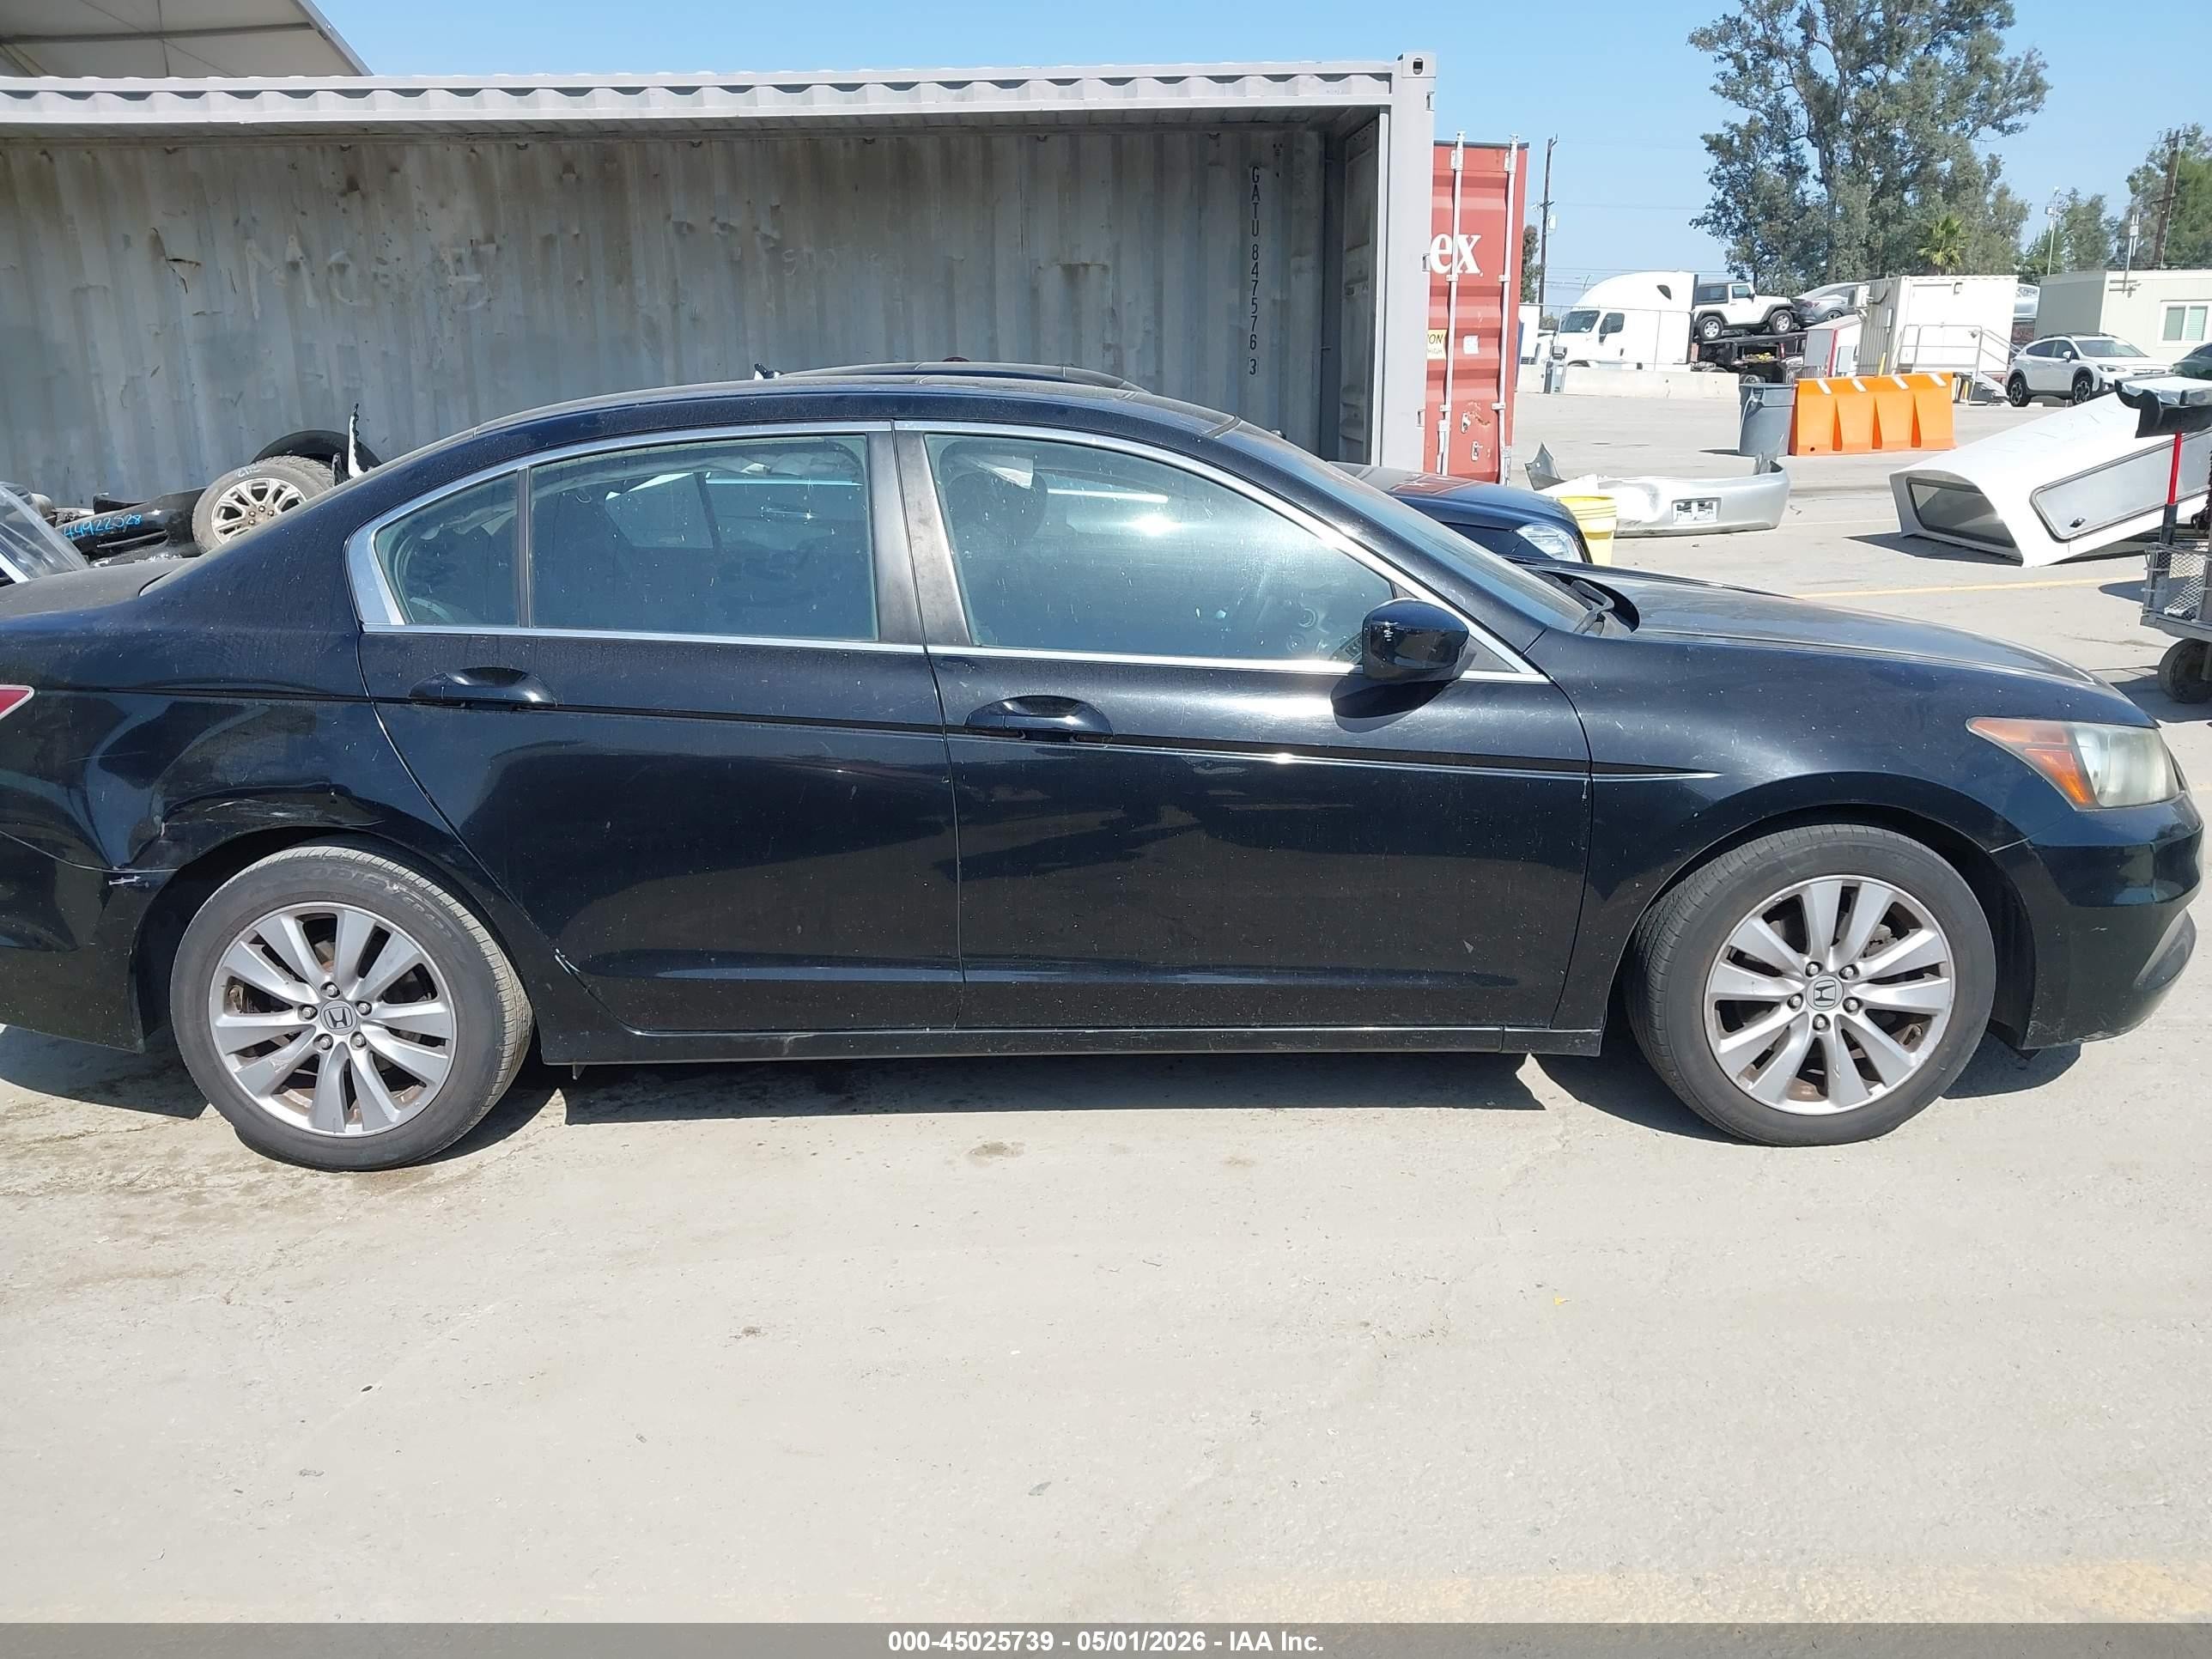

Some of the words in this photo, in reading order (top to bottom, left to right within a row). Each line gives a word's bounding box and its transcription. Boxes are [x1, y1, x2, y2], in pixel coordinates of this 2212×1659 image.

[1251, 166, 1261, 237] GATU
[1249, 243, 1260, 350] 847576
[1427, 334, 1443, 344] ON
[1249, 358, 1258, 375] 3
